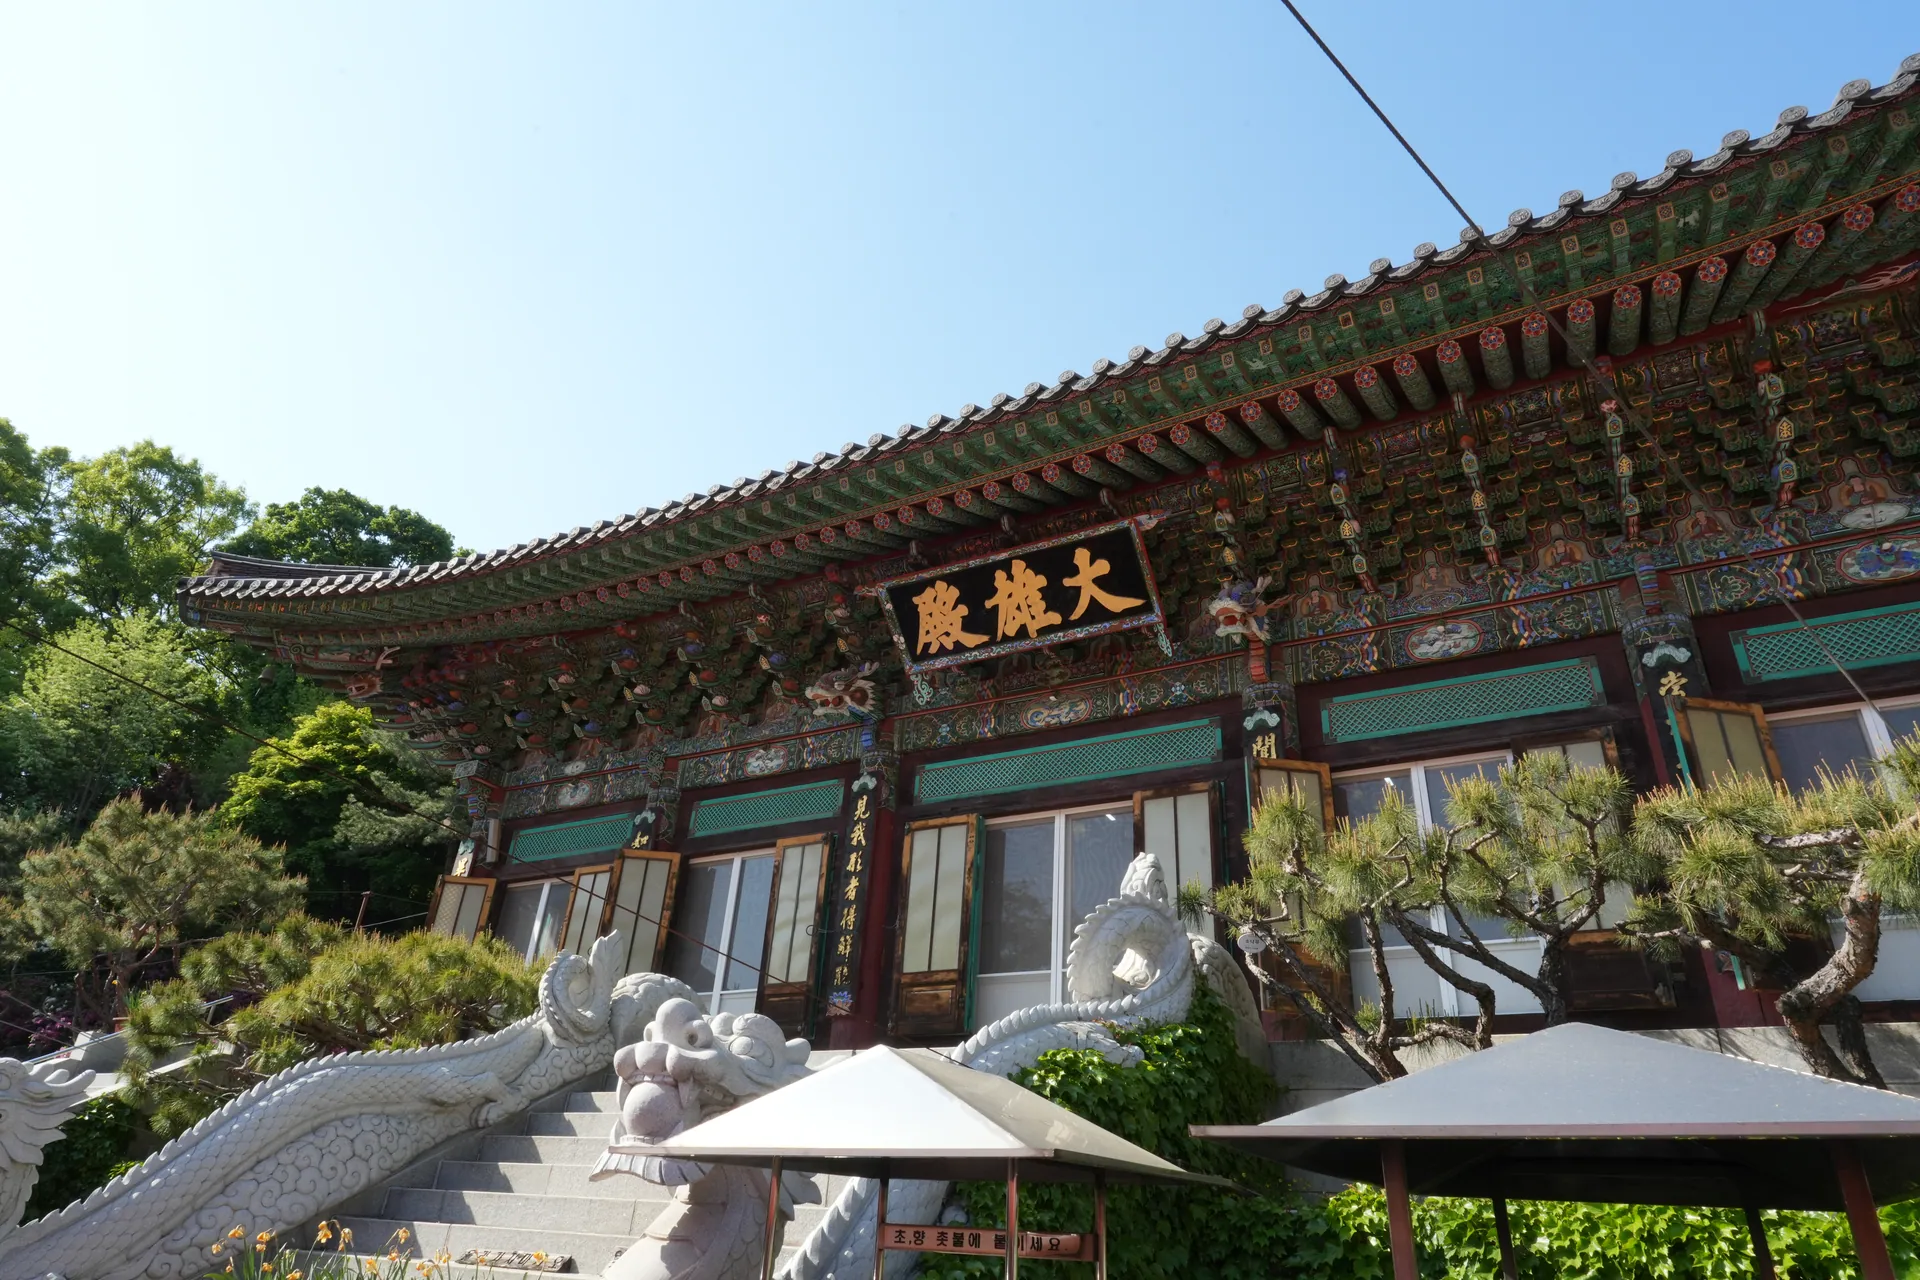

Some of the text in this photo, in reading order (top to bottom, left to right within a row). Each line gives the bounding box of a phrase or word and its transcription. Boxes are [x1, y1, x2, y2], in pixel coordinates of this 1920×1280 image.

[912, 547, 1147, 656] 大雄殿
[894, 1229, 926, 1246] 초,향
[936, 1230, 981, 1249] 촛불에
